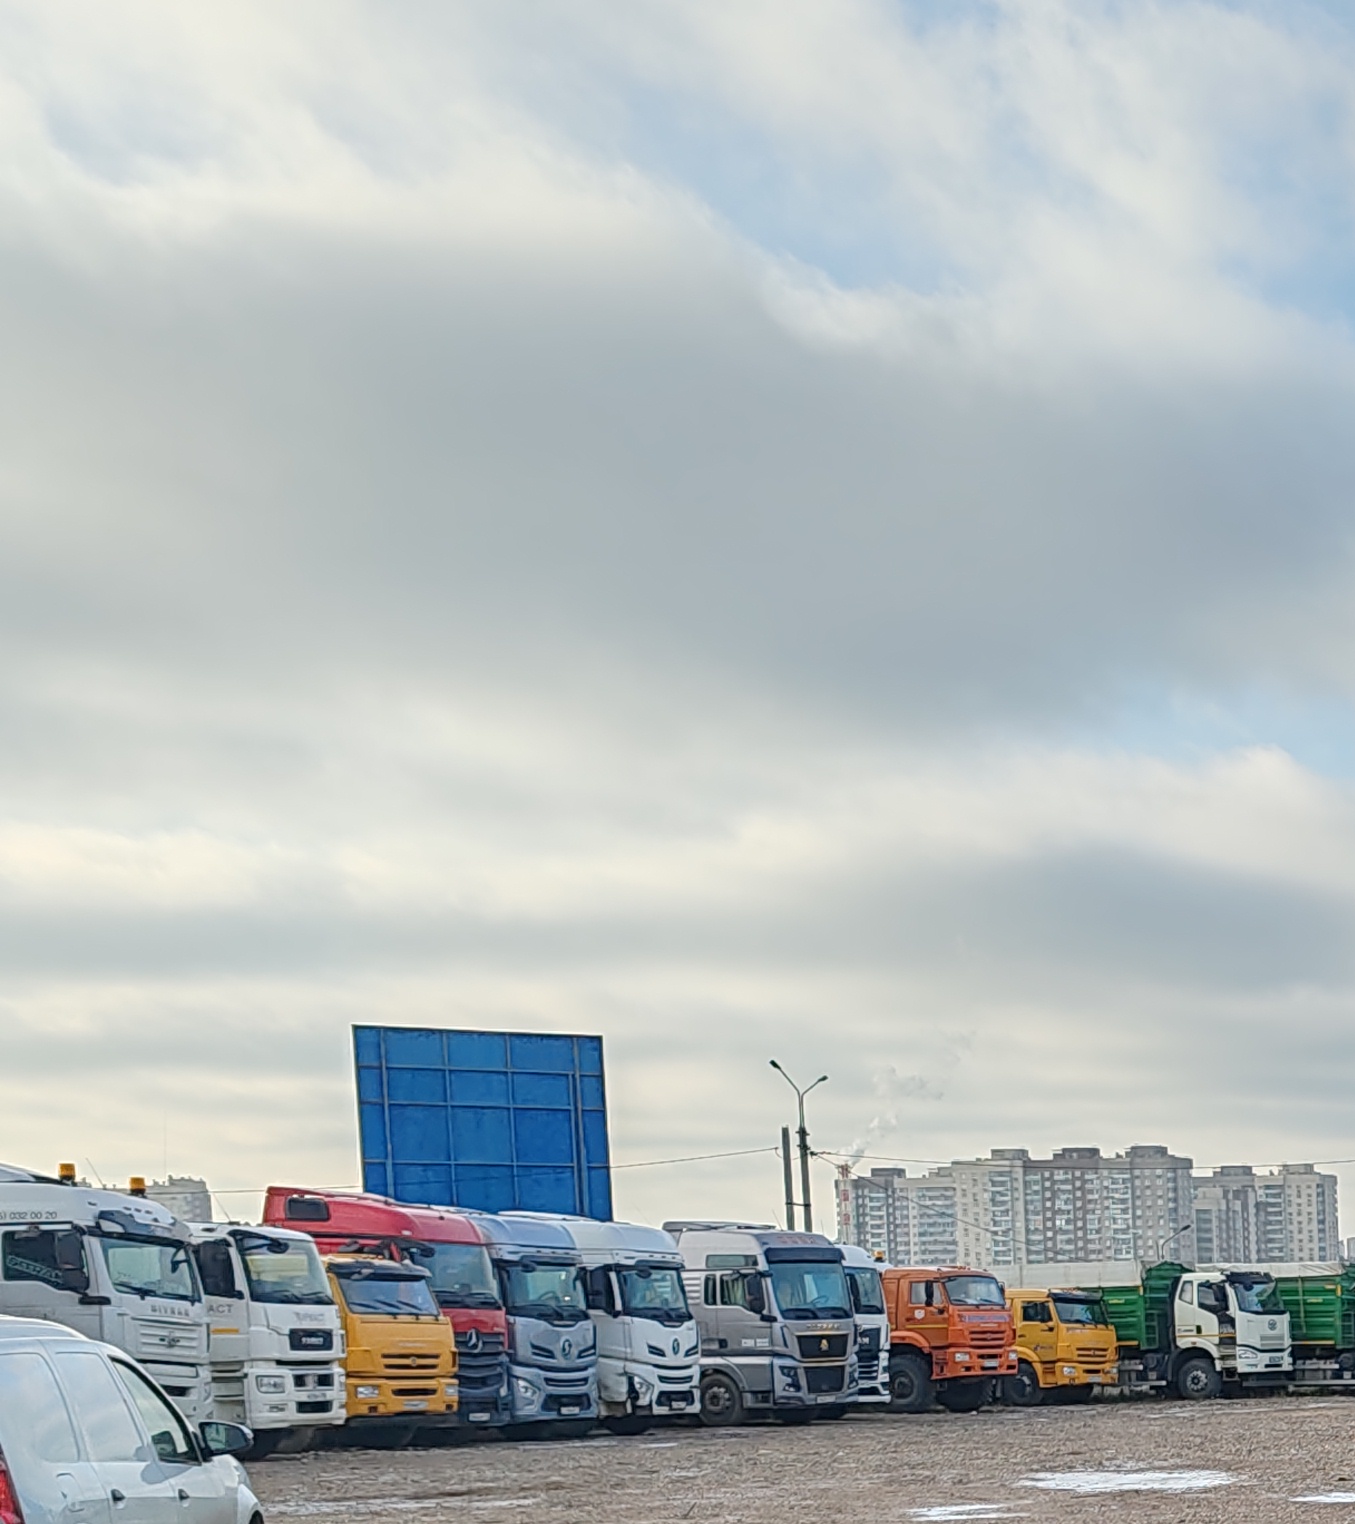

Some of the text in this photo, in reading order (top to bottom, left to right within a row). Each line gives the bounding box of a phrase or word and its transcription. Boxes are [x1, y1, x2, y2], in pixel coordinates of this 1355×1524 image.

[9, 1211, 28, 1220] 032
[30, 1211, 42, 1220] 00
[45, 1211, 57, 1220] 20
